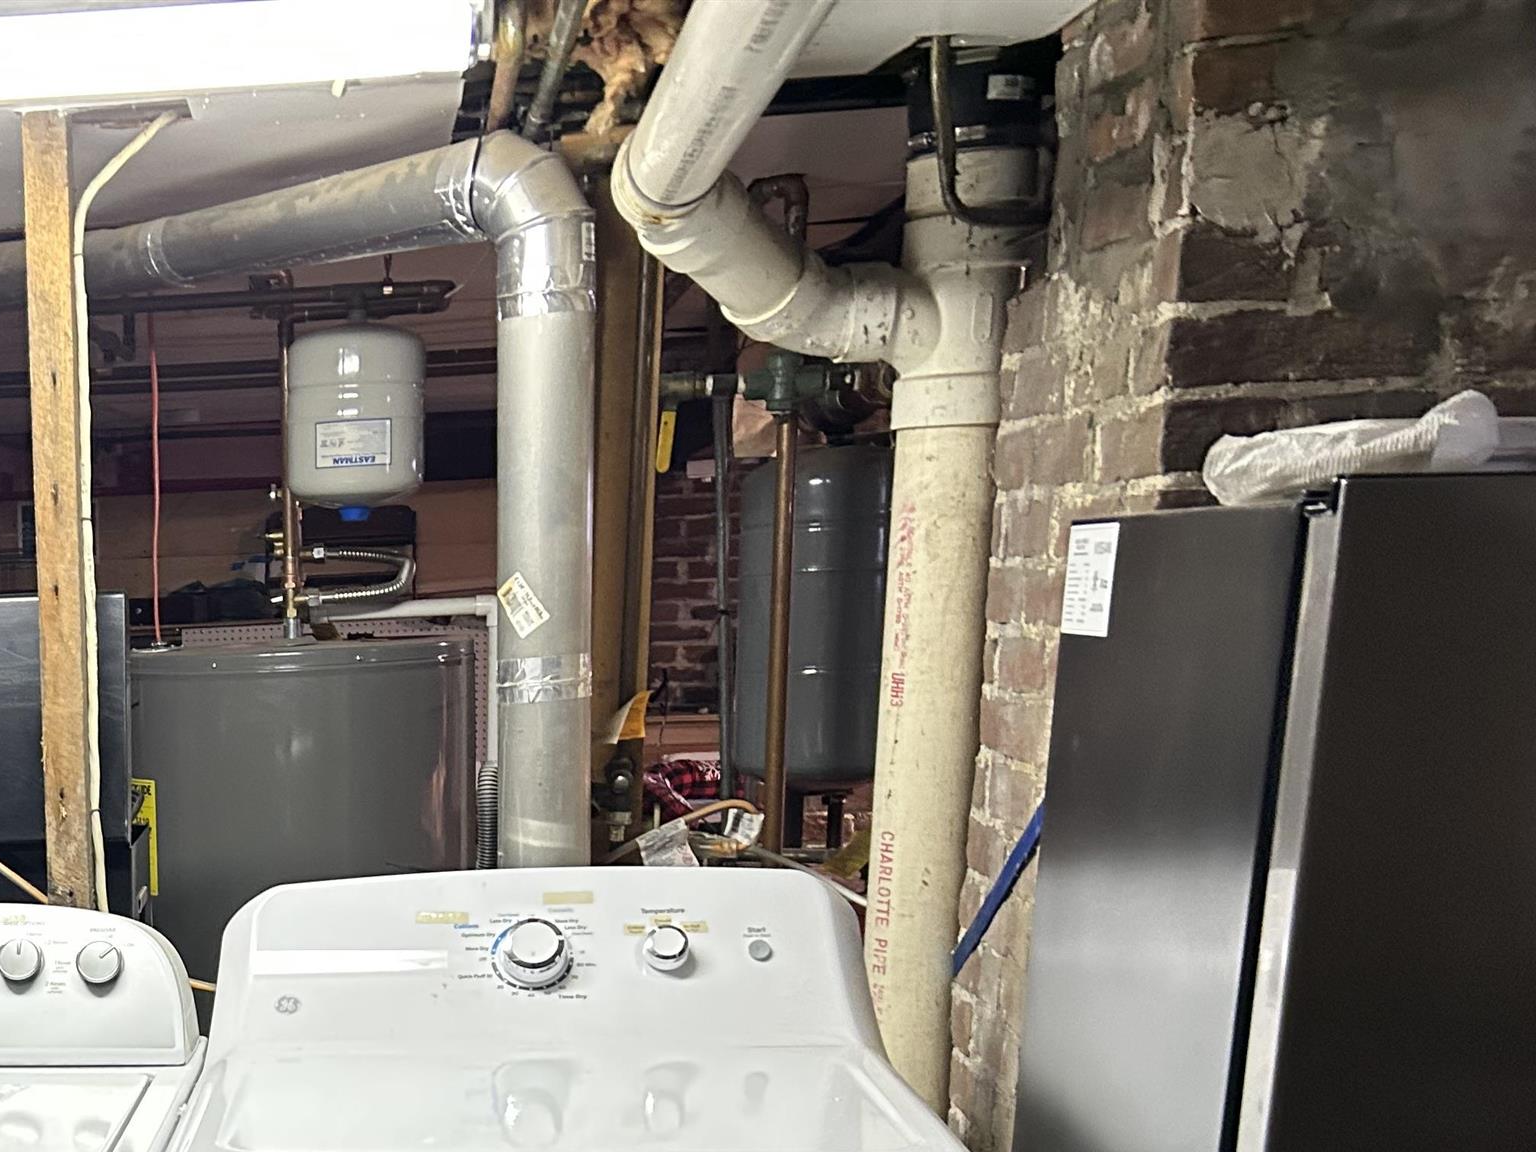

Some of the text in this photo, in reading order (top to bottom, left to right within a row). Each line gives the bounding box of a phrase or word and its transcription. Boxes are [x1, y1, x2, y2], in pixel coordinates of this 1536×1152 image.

[333, 455, 376, 465] EASTMAN
[874, 831, 896, 928] CHARLOTTE
[641, 907, 686, 916] Temperature
[871, 938, 889, 975] PIPE
